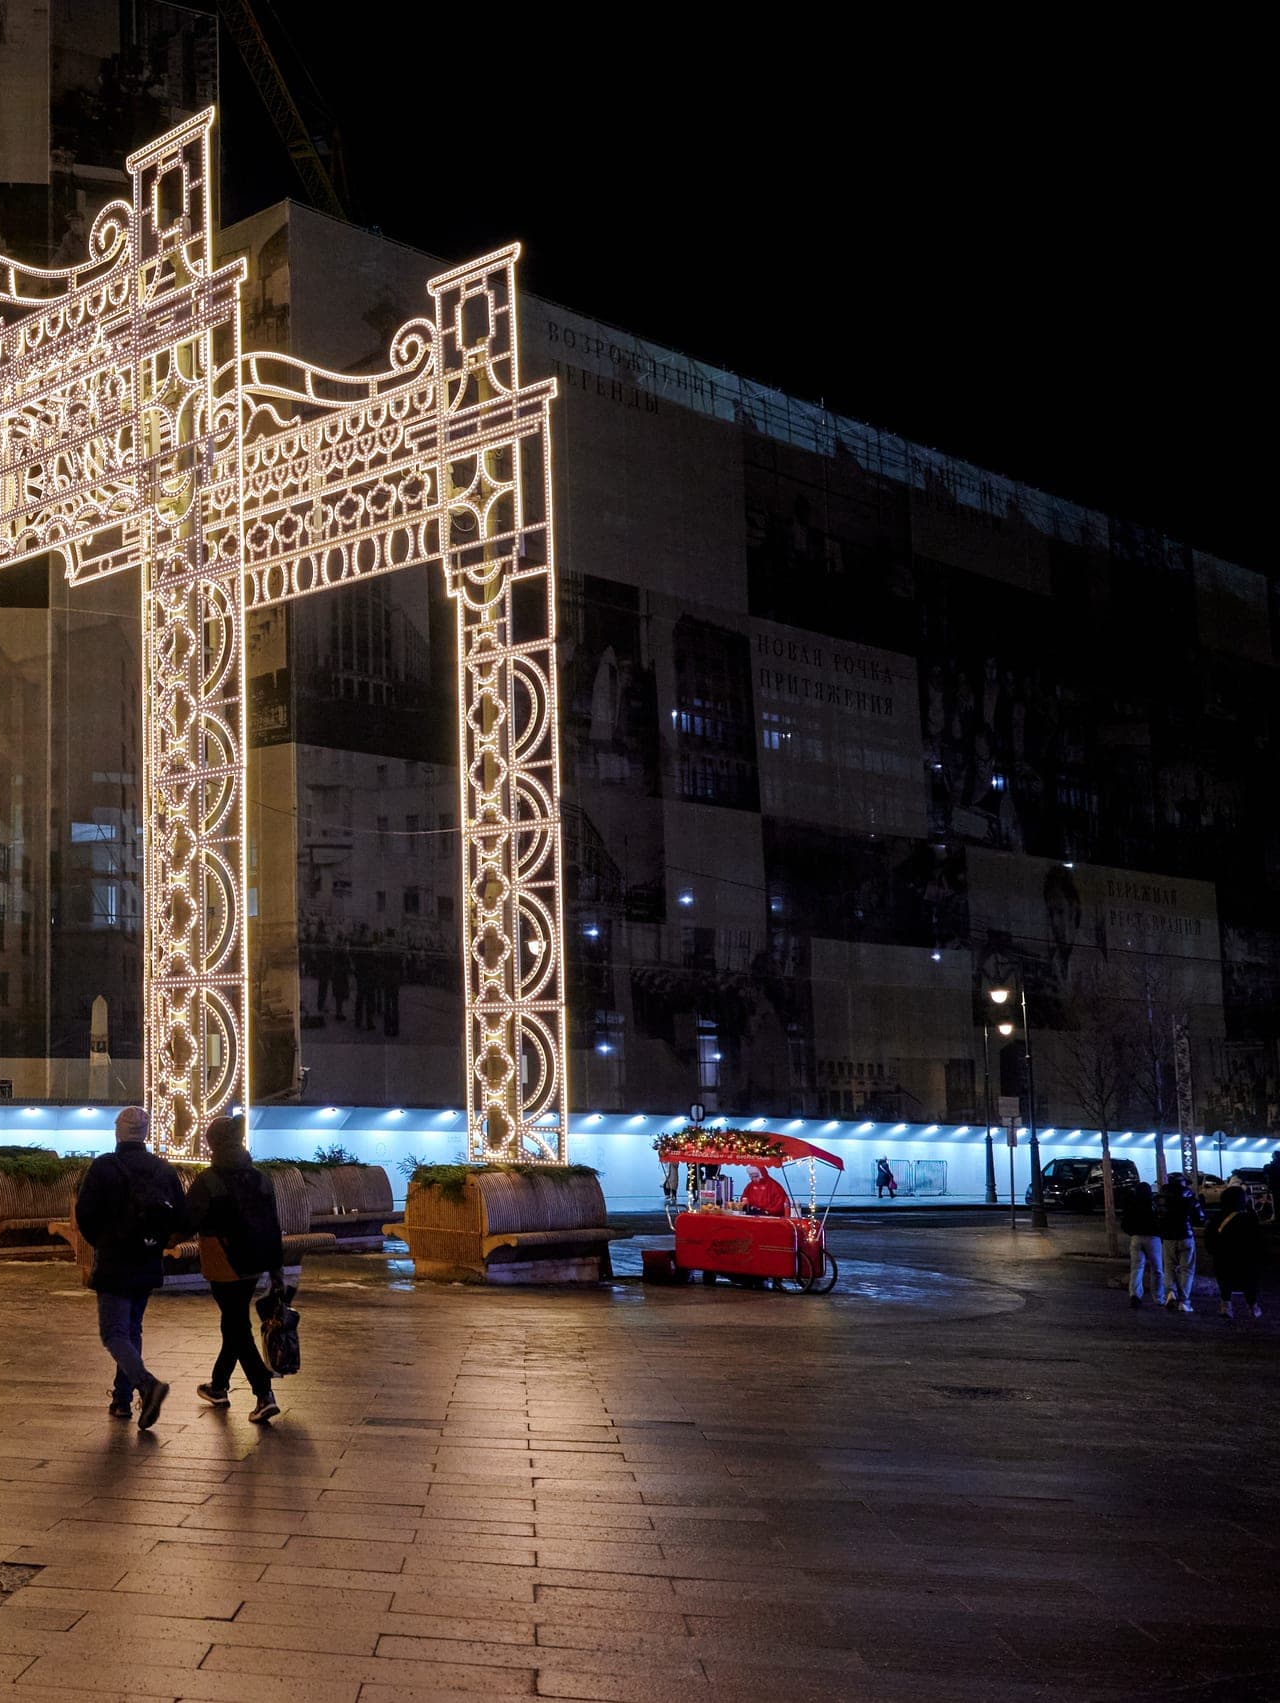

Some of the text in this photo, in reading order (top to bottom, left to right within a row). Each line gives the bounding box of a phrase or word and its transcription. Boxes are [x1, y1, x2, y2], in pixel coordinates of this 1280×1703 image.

[758, 633, 893, 685] НОВАЯ ТОЧКА
[759, 667, 893, 715] ПРИТЯЖЕНИЯ
